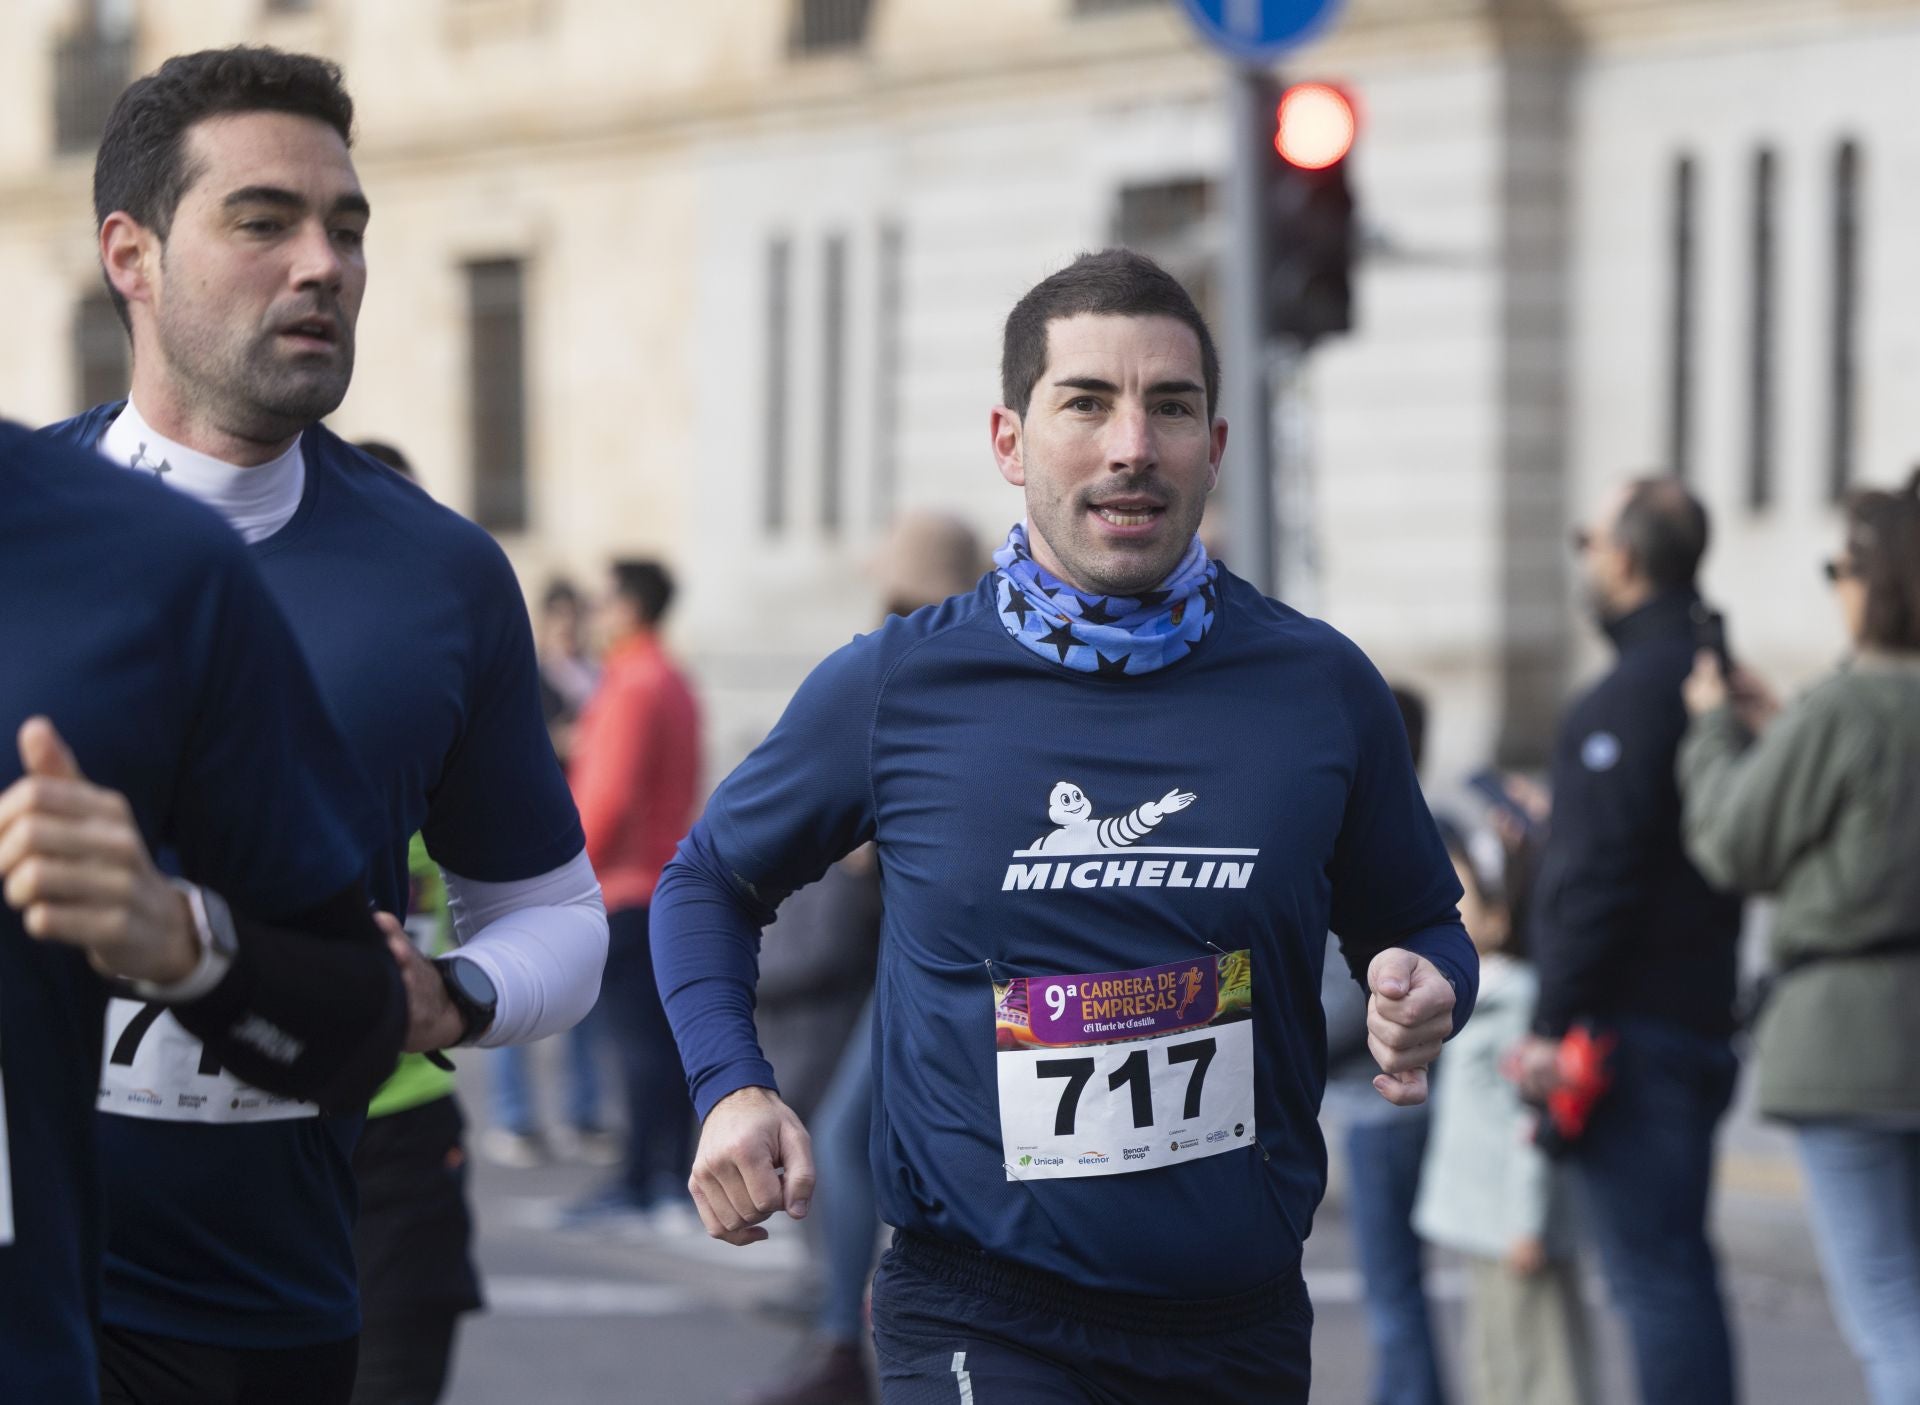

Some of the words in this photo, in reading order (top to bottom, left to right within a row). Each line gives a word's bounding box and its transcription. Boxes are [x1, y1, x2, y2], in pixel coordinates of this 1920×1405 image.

[1002, 861, 1255, 891] MICHELIN
[1080, 976, 1154, 999] CARRERA
[1158, 971, 1177, 989] DE
[1081, 989, 1178, 1020] EMPRESAS
[1083, 1023, 1094, 1033] El
[1095, 1020, 1117, 1032] Norte
[1117, 1020, 1126, 1030] de
[1126, 1016, 1156, 1028] Castilla
[1036, 1037, 1217, 1136] 717
[1123, 1145, 1150, 1155] Renault
[1123, 1151, 1146, 1160] Group
[1034, 1157, 1064, 1166] Unicaja
[1078, 1156, 1110, 1165] elecnor
